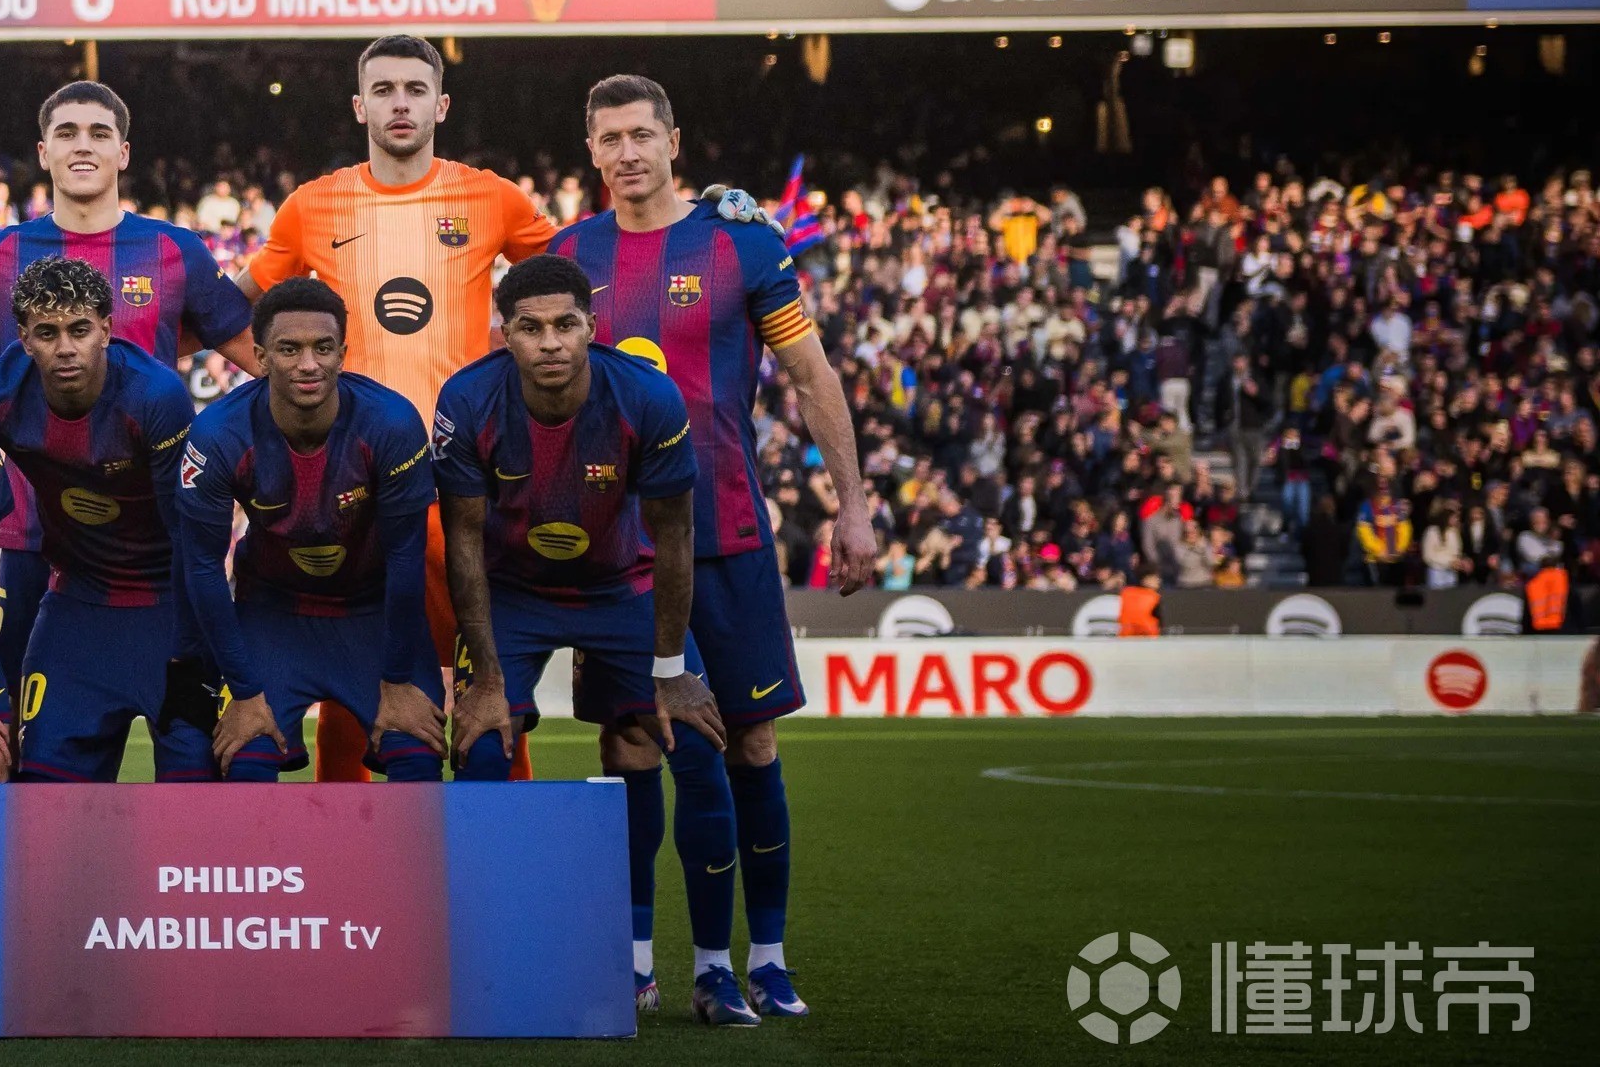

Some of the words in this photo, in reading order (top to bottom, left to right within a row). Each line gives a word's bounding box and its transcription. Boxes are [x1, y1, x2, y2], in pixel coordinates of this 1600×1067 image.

[826, 650, 1093, 717] MARO
[158, 866, 305, 893] PHILIPS
[84, 917, 329, 950] AMBILIGHT
[340, 920, 381, 950] tv
